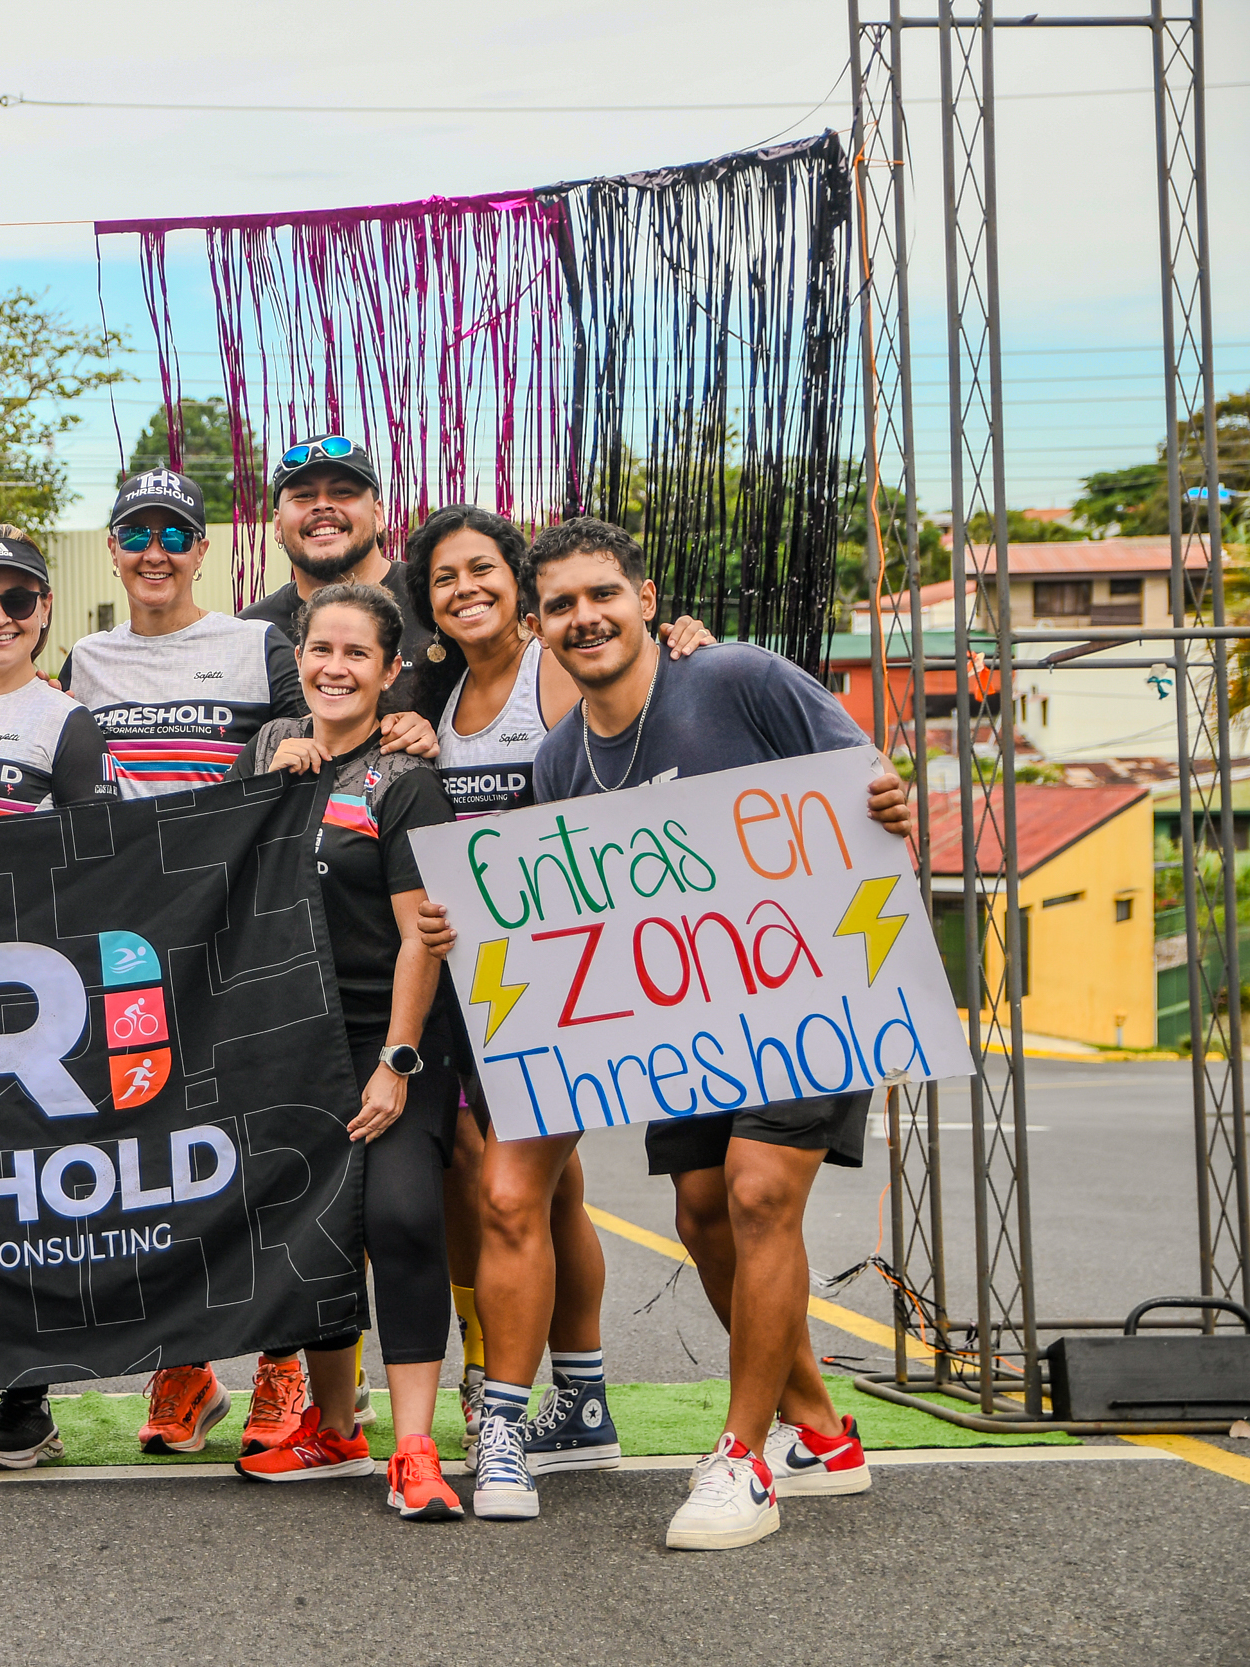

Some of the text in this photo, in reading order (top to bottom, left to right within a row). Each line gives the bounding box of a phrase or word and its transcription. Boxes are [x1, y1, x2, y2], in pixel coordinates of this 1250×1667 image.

[125, 486, 195, 507] THRESHOLD
[193, 670, 225, 682] Safetti
[156, 725, 212, 734] CONSULTING
[498, 732, 529, 747] Safetti
[467, 794, 508, 803] CONSULTING
[467, 788, 853, 929] Entras en
[483, 987, 931, 1137] Threshold
